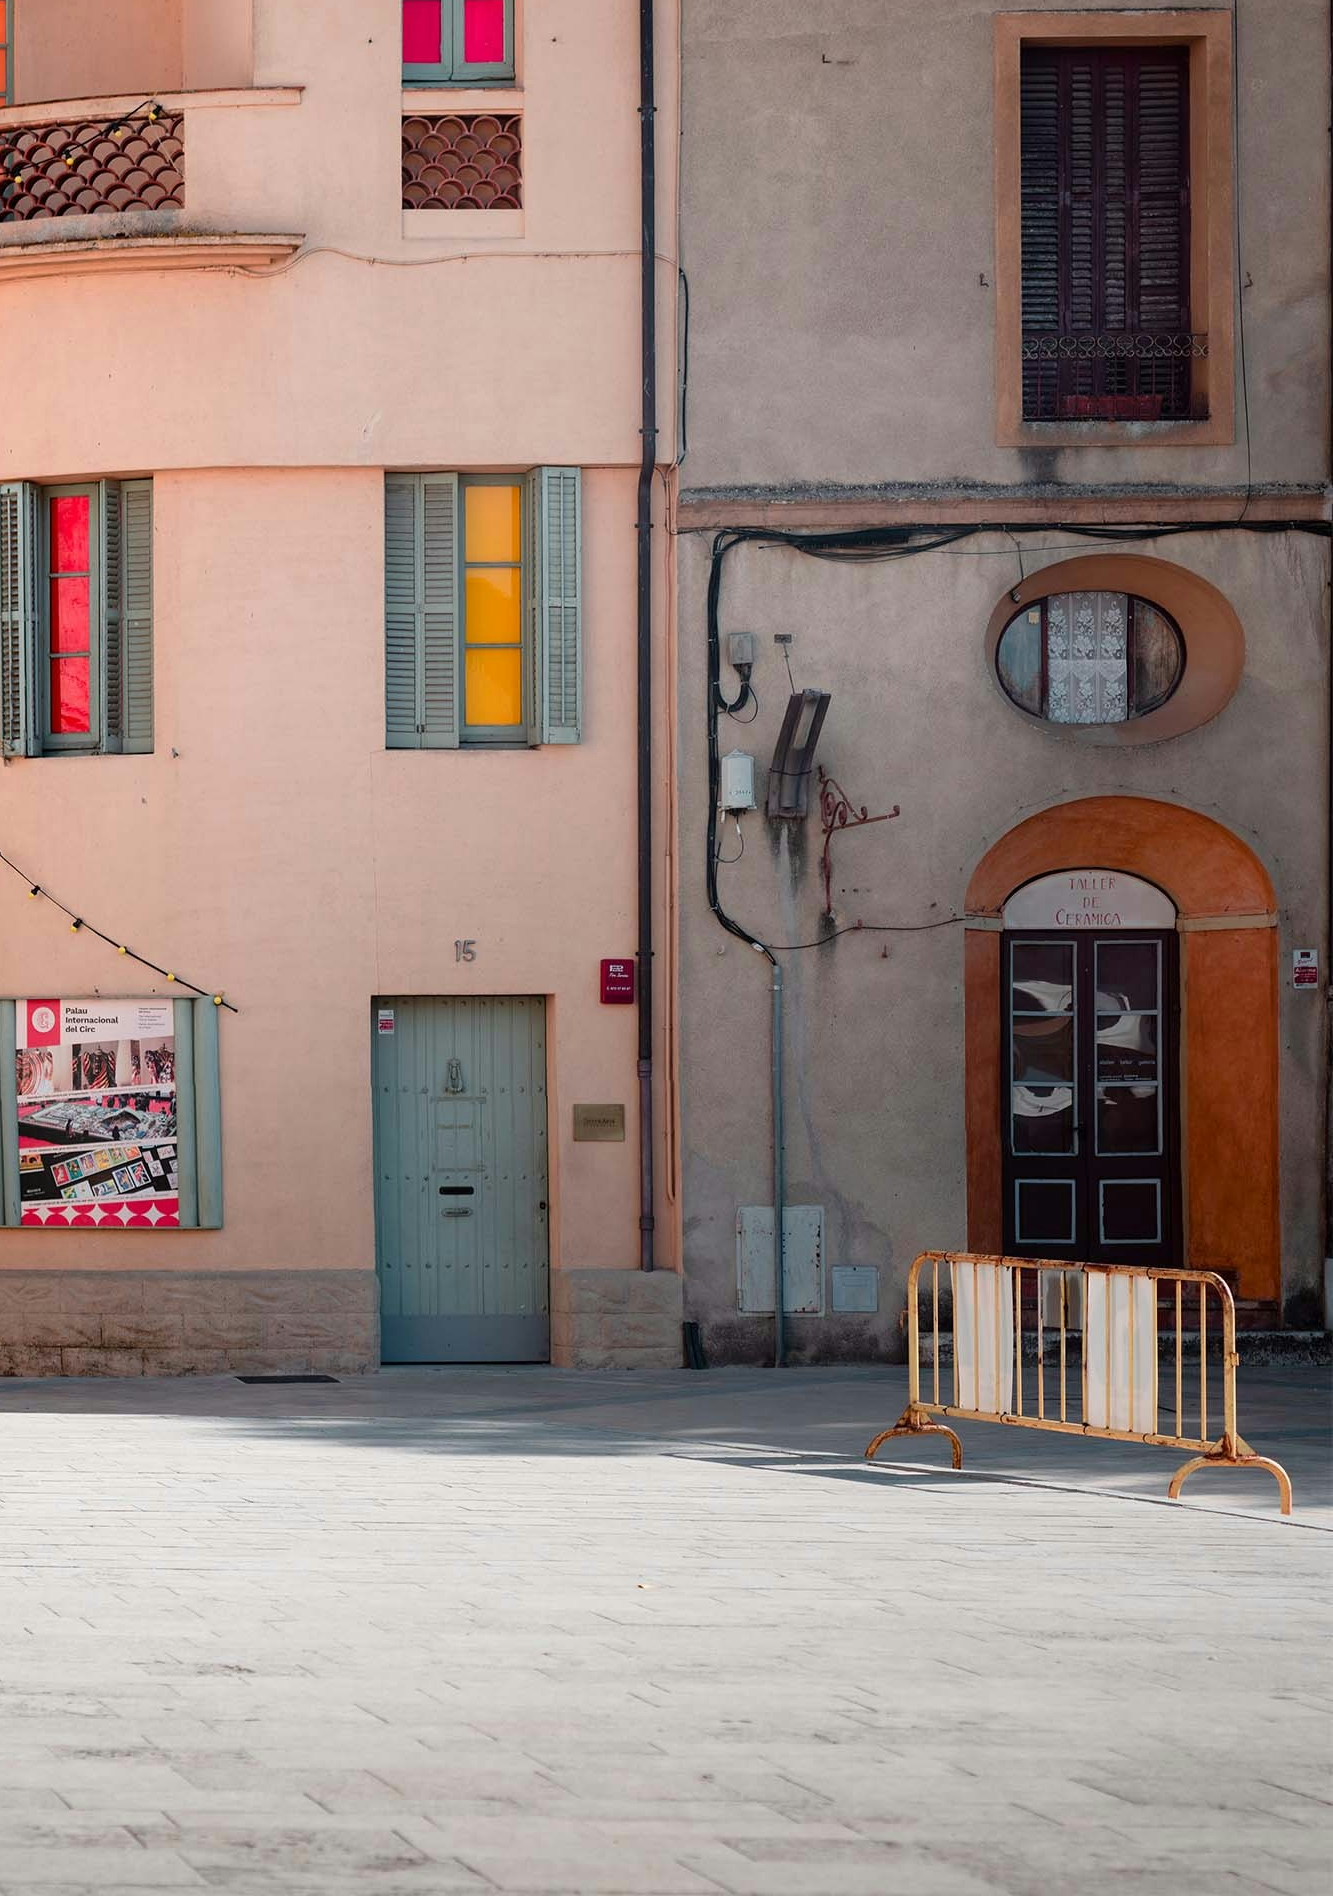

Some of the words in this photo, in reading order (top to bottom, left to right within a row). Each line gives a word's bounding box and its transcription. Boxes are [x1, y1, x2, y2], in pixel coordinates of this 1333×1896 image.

[1069, 878, 1116, 890] TALLER
[1083, 896, 1101, 908] DE
[454, 939, 477, 963] 15
[65, 1007, 88, 1015] Palau
[65, 1016, 119, 1024] Internacional
